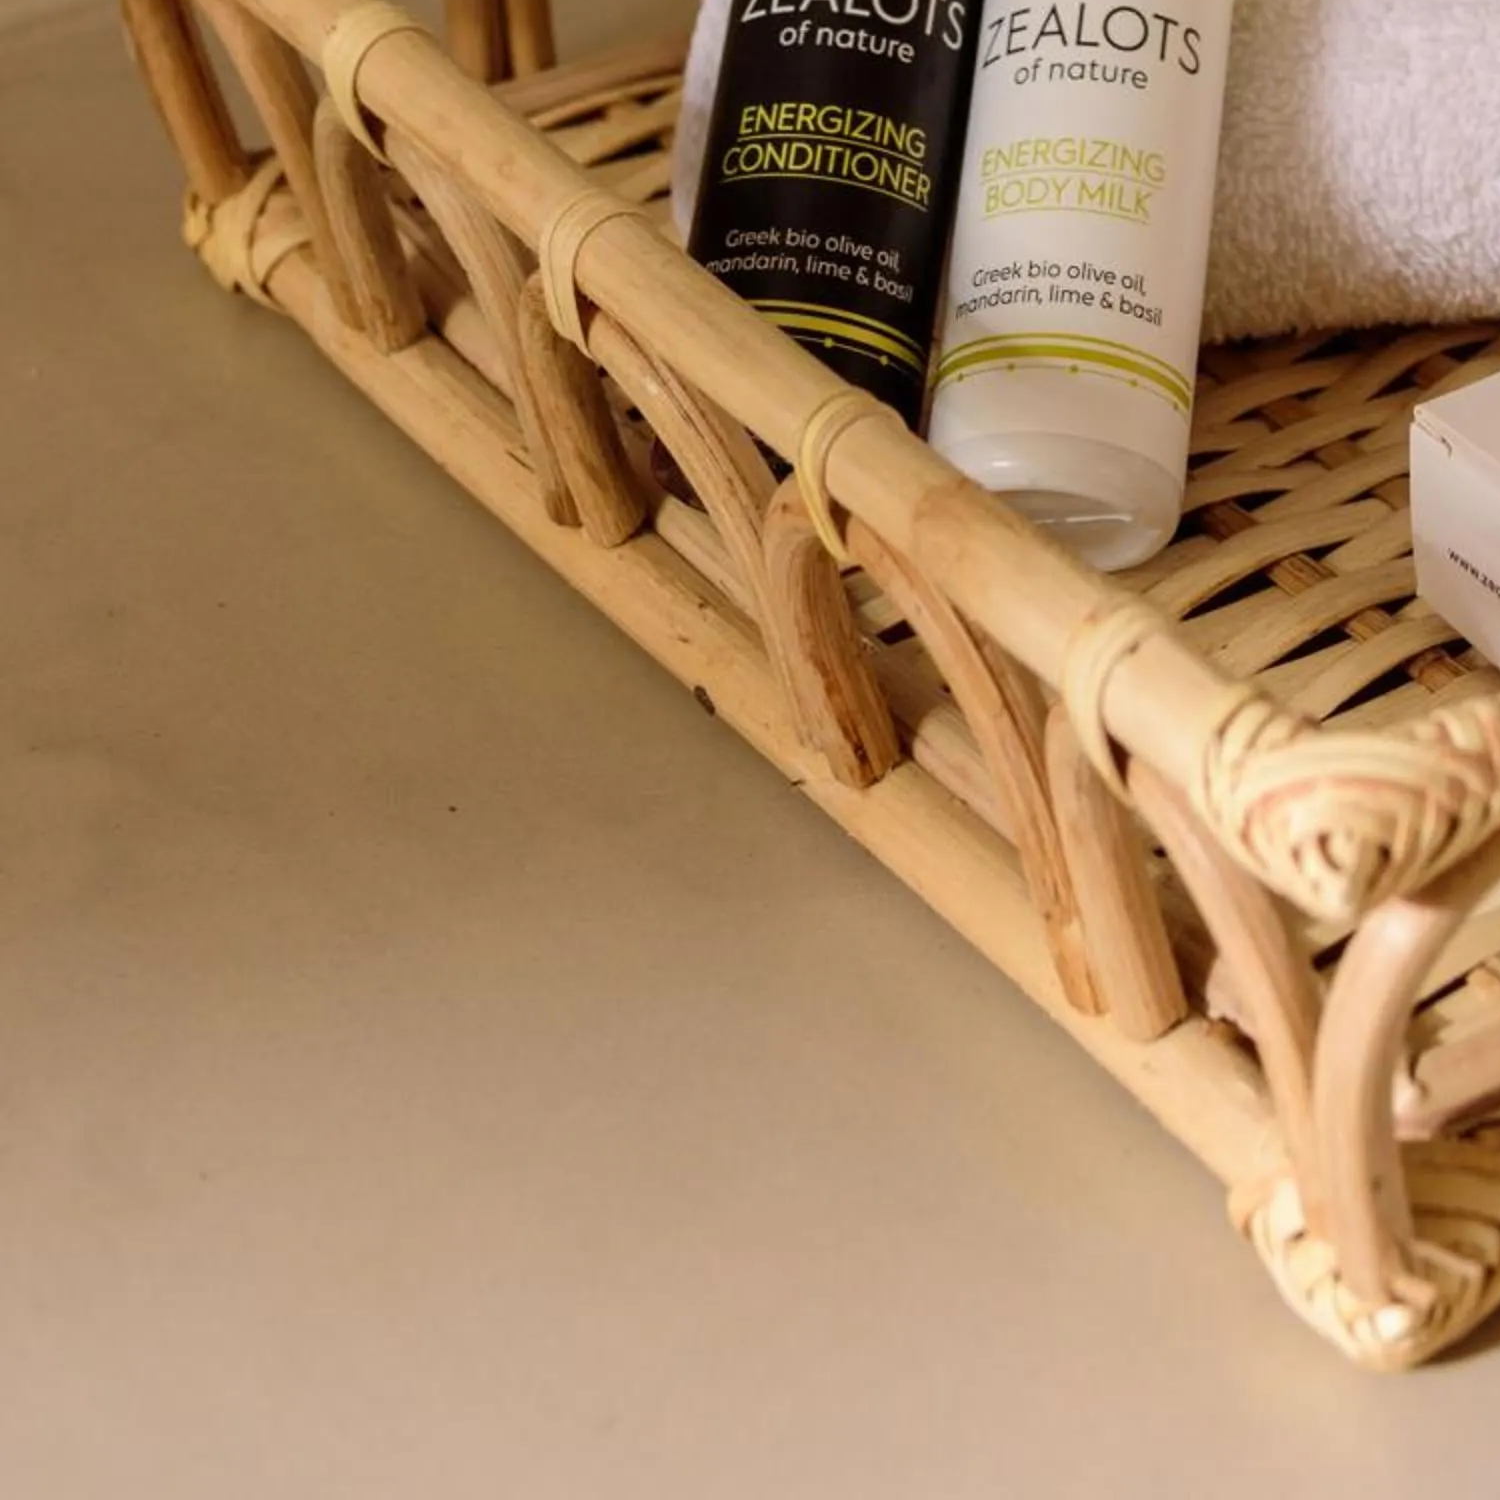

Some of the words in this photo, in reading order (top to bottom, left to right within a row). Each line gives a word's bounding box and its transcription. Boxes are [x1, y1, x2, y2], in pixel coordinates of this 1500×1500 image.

[779, 20, 811, 46] of
[816, 26, 915, 62] nature
[982, 2, 1200, 75] ZEALOTS
[1013, 57, 1043, 85] of
[1049, 60, 1148, 88] nature
[739, 103, 926, 158] ENERGIZING
[722, 142, 931, 205] CONDITIONER
[980, 137, 1165, 183] ENERGIZING
[985, 177, 1071, 214] BODY
[1077, 178, 1152, 218] MILK
[725, 228, 780, 248] Greek
[786, 228, 820, 248] bio
[825, 236, 873, 260] olive
[706, 252, 799, 274] mandarin,
[806, 255, 851, 280] lime
[855, 266, 869, 285] &
[874, 271, 914, 303] basil
[973, 261, 1023, 287] Greek
[1028, 260, 1061, 278] bio
[1067, 261, 1116, 284] olive
[955, 285, 1043, 320] mandarin,
[1050, 285, 1094, 306] lime
[1101, 291, 1114, 310] &
[1119, 294, 1163, 326] basil
